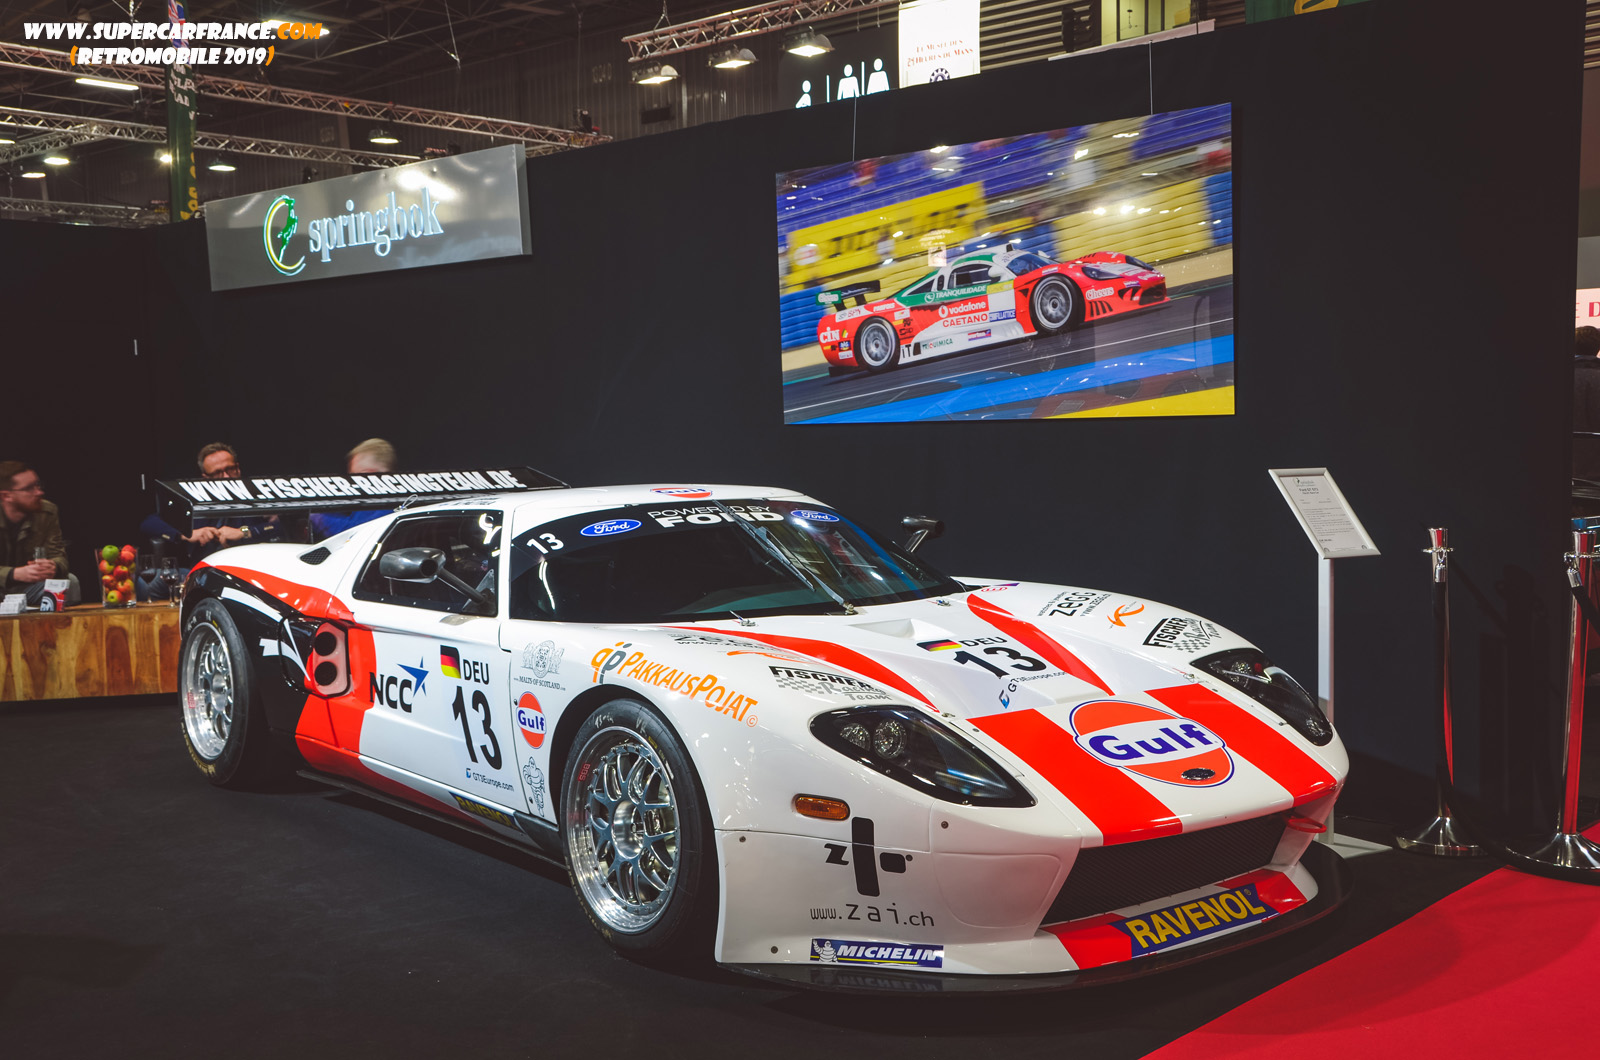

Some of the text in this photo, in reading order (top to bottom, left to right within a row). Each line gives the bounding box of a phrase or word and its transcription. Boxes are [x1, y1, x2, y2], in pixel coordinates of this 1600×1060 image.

[308, 187, 445, 263] springbok
[935, 285, 987, 299] TRANQUILIDADE
[949, 300, 987, 314] vodafone
[942, 313, 988, 328] CAETANO
[593, 521, 631, 534] Ford
[526, 532, 564, 555] 13
[958, 636, 1008, 647] DEU
[1143, 617, 1190, 648] FISCHER
[463, 659, 489, 685] DEU
[953, 646, 1047, 680] 13
[769, 666, 875, 690] FISCHER
[369, 671, 412, 713] NCC
[452, 685, 502, 771] 13
[518, 709, 545, 732] Gulf
[1089, 724, 1214, 761] Gulf
[810, 902, 935, 927] www.zai.ch
[1125, 889, 1266, 949] RAVENOL
[837, 944, 940, 961] MICHELIN
